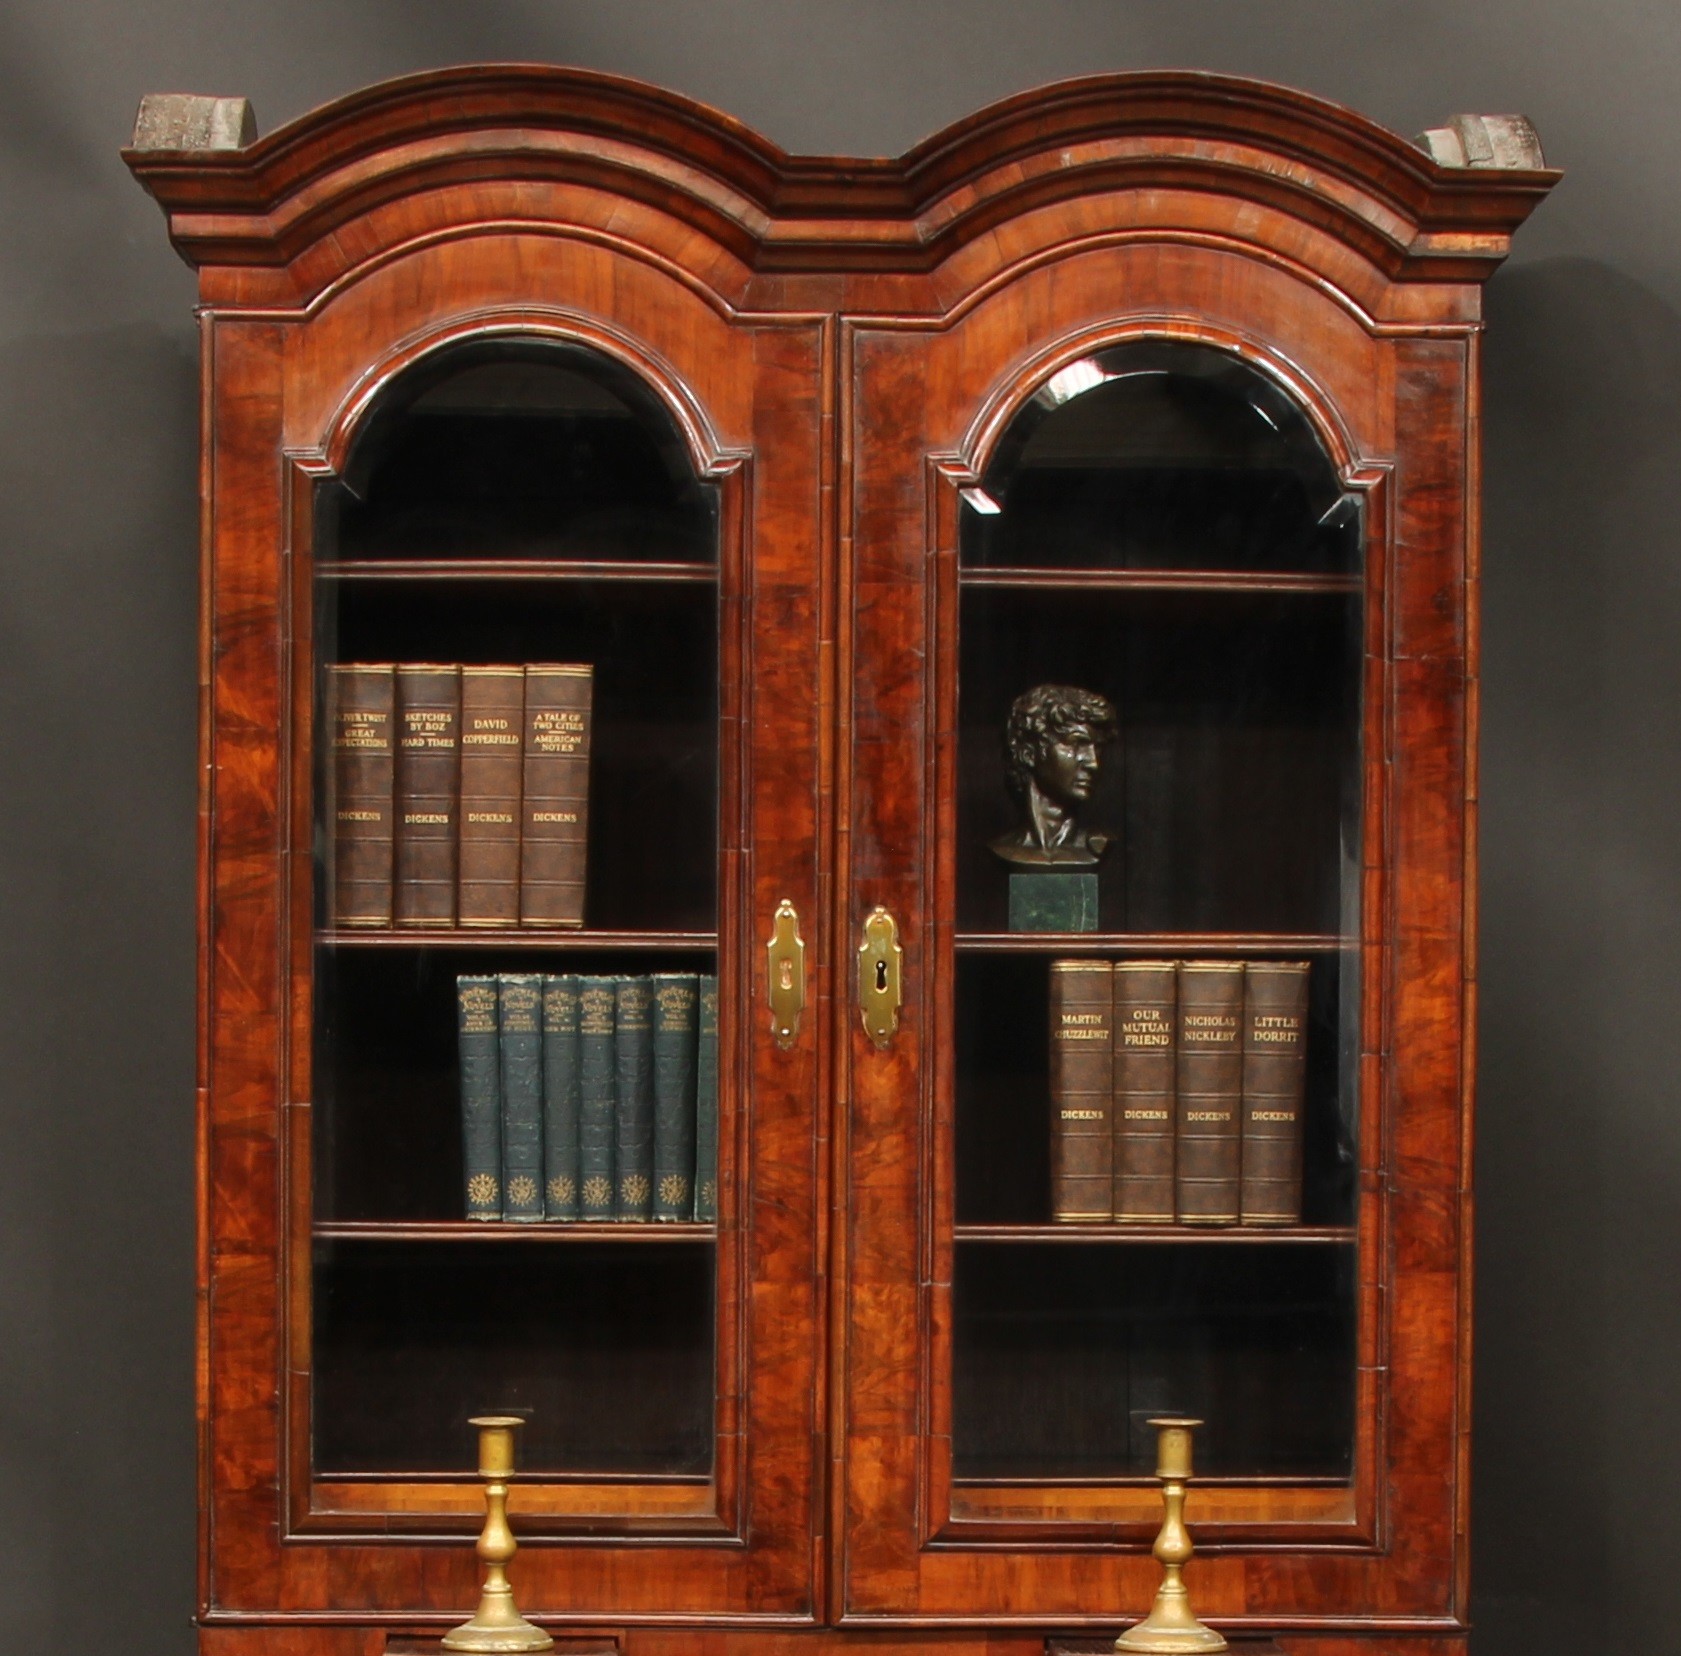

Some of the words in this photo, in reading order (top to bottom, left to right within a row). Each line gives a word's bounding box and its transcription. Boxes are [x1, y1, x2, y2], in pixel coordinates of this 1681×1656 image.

[405, 712, 452, 723] SKETCHES
[536, 714, 543, 722] A
[544, 713, 567, 722] TALE
[569, 713, 580, 722] OF
[410, 722, 422, 731] BY
[425, 722, 446, 731] BOZ
[474, 719, 508, 730] DAVID
[533, 722, 553, 730] TWO
[555, 722, 584, 731] CITIES
[344, 729, 376, 738] GREAT
[401, 738, 425, 748] HARD
[427, 738, 455, 748] TIMES
[462, 734, 519, 745] COPPERFIELD
[533, 735, 582, 744] AMERICAN
[541, 743, 575, 752] NOTES
[338, 811, 382, 822] DICKENS
[404, 814, 449, 824] DICKENS
[468, 813, 513, 823] DICKENS
[532, 812, 577, 823] DICKENS
[1061, 1014, 1102, 1025] MARTIN
[1132, 1010, 1160, 1020] OUR
[1184, 1016, 1236, 1027] NICHOLAS
[1254, 1016, 1299, 1028] LITTLE
[1122, 1022, 1170, 1033] MUTUAL
[1124, 1034, 1170, 1046] FRIEND
[1184, 1030, 1236, 1042] NICKLEBY
[1253, 1031, 1299, 1042] DORRIT
[1061, 1110, 1104, 1120] DICKENS
[1124, 1110, 1168, 1120] DICKENS
[1187, 1111, 1232, 1122] DICKENS
[1251, 1111, 1296, 1122] DICKENS
